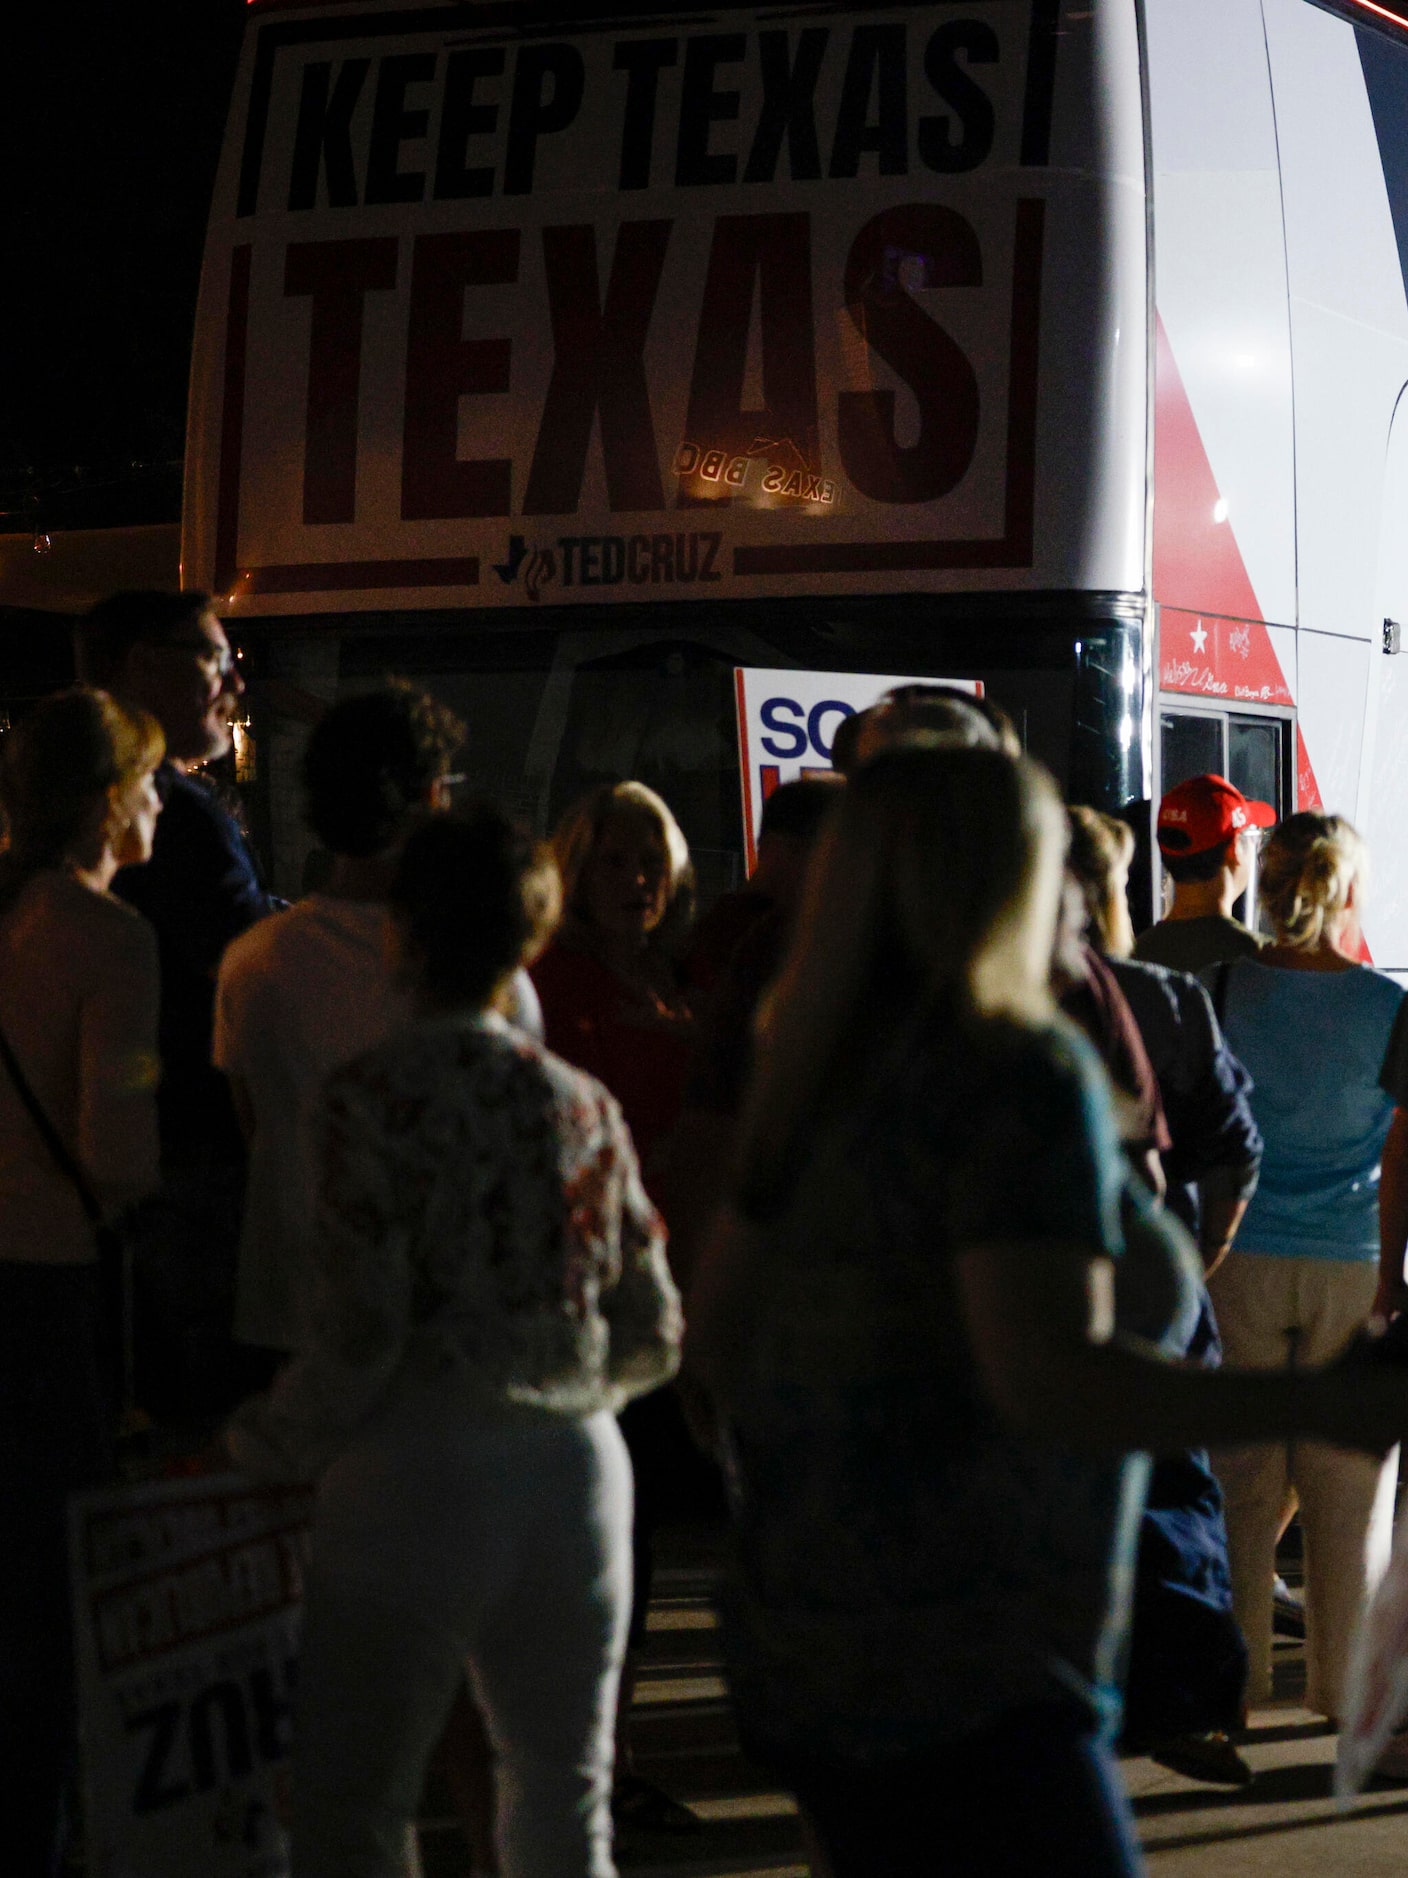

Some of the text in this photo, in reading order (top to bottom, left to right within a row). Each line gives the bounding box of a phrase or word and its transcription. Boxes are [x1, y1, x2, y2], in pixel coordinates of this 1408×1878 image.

[288, 19, 1000, 212] KEEP TEXAS
[284, 203, 983, 526] TEXAS
